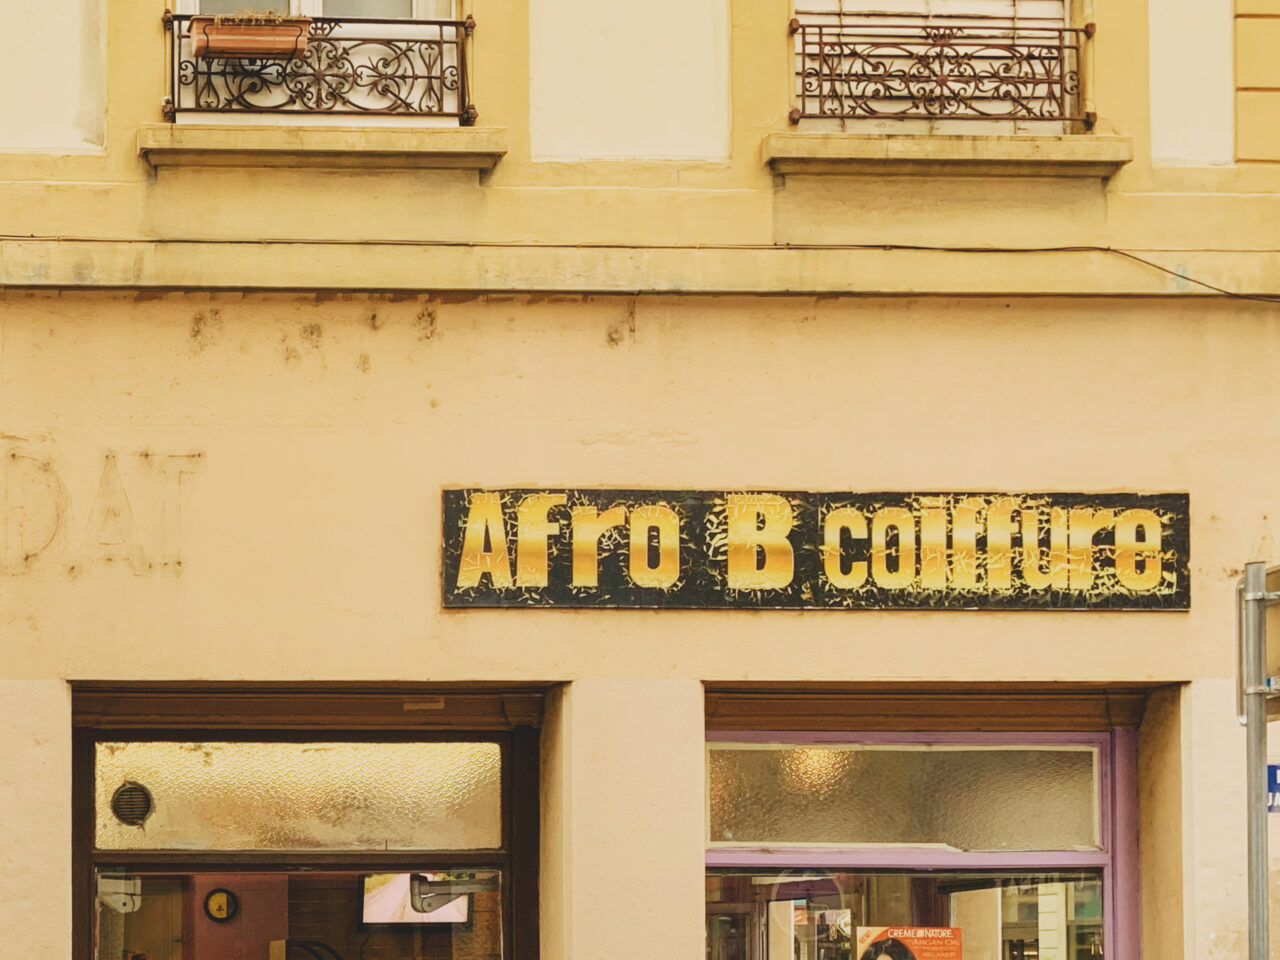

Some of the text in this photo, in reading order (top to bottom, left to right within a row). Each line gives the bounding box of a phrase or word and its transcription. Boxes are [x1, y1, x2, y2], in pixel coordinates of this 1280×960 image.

[456, 491, 1163, 593] Afro B coiffure
[888, 928, 917, 938] CREME
